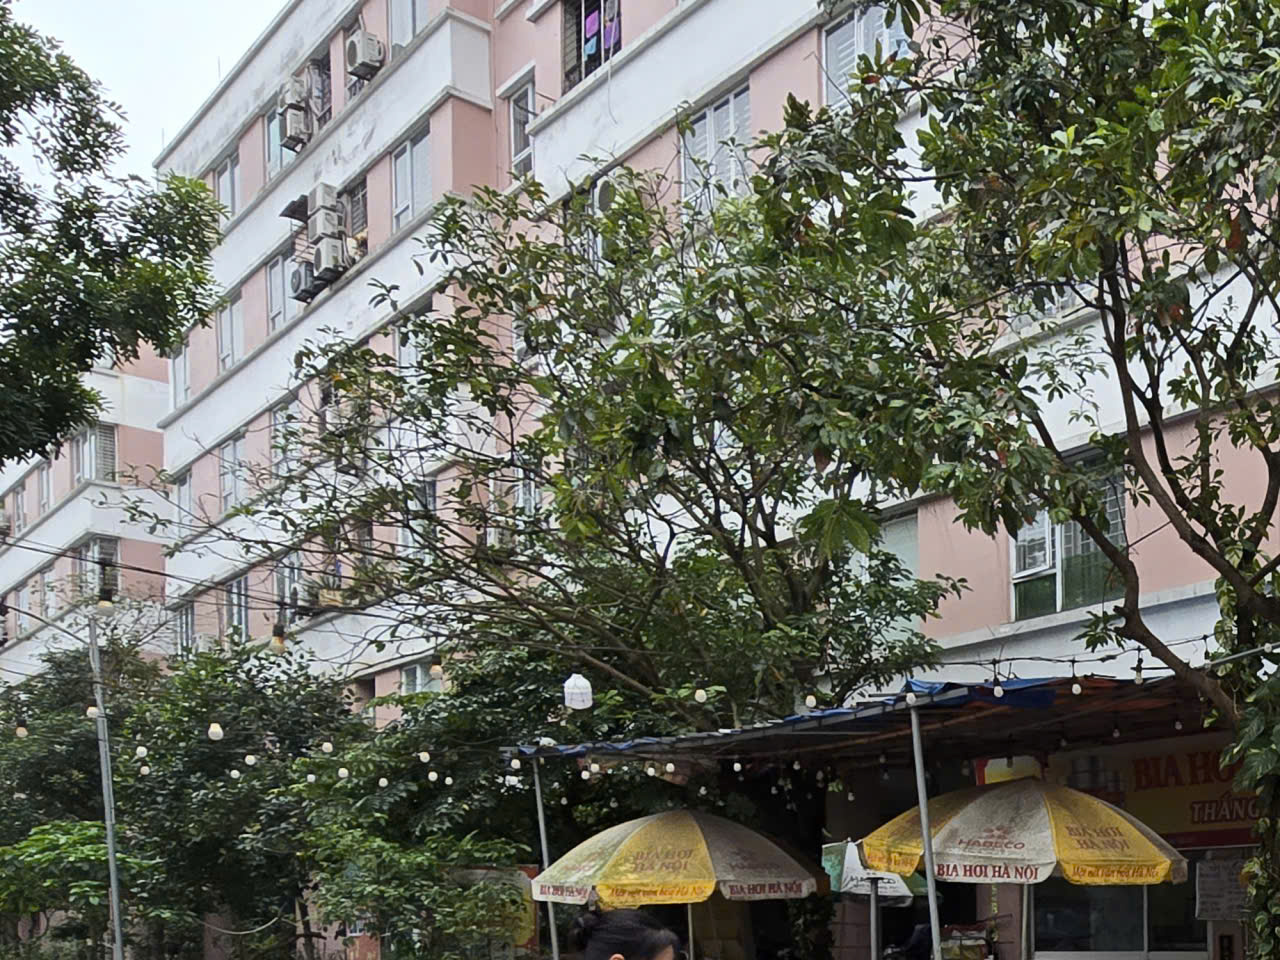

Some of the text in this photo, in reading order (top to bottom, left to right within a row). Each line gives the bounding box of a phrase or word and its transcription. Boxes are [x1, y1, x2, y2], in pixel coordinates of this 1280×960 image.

[1132, 754, 1184, 789] BIA
[937, 862, 1040, 881] BIA HƠI HÀ NỘI
